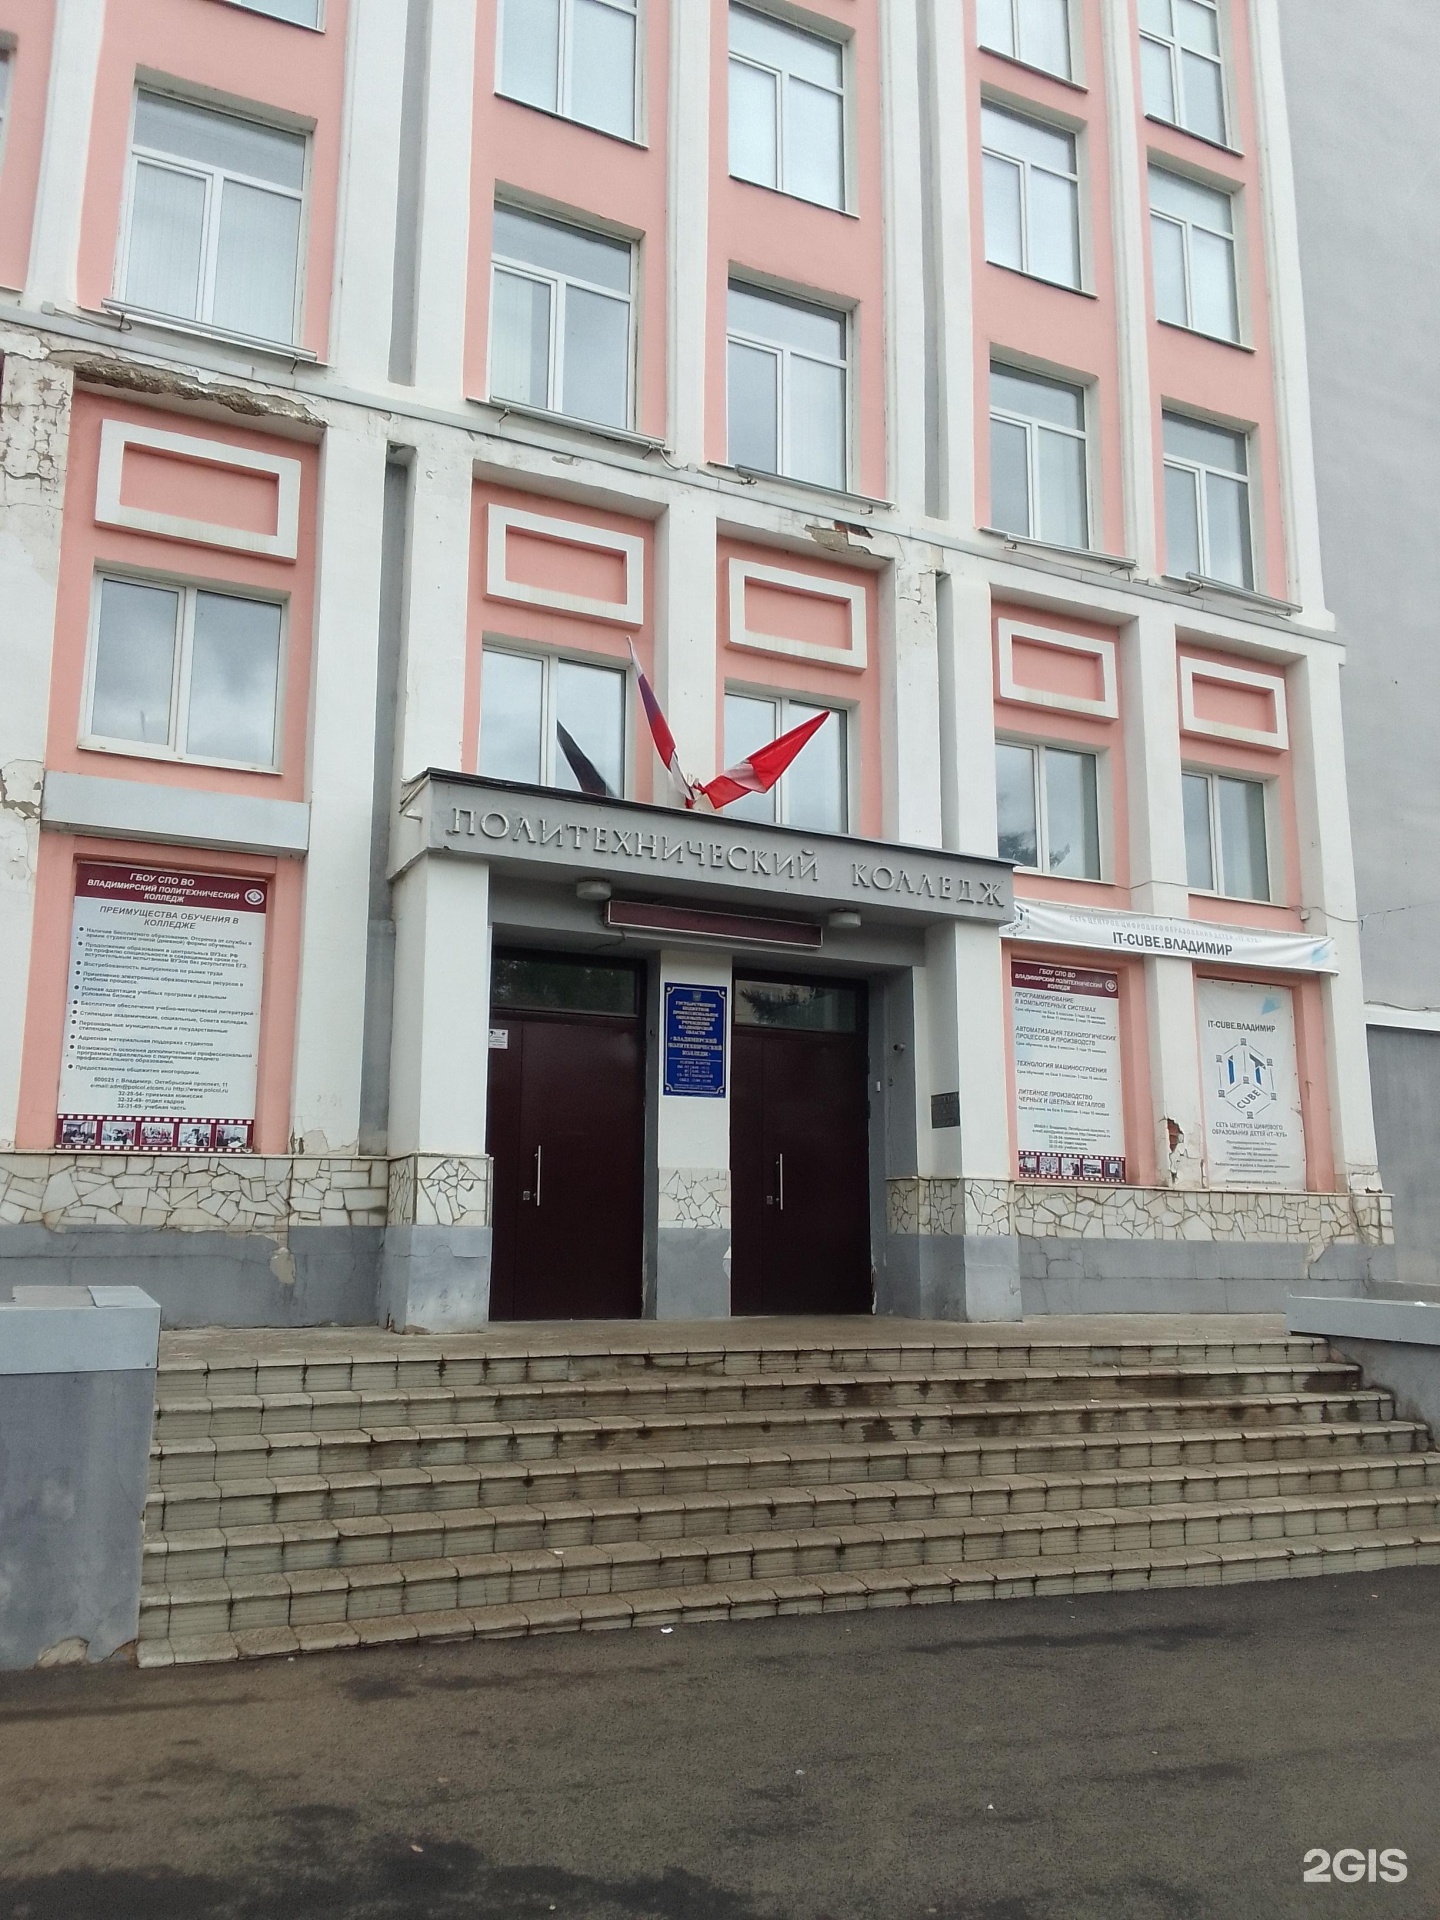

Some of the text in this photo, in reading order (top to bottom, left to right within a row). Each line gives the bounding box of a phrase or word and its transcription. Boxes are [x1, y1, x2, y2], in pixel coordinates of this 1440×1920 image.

[452, 808, 1005, 907] ПОЛИТЕХНИЧЕСКИЙ КОЛЛЕДЖ
[130, 873, 194, 886] ГБОУ СПО ВО
[87, 878, 240, 900] ВЛАДИМИРСКИЙ ПОЛИТЕХНИЧЕСКИЙ
[144, 892, 184, 904] КОЛЛЕДЖ
[100, 906, 178, 920] ПРЕИМУЩЕСТВА
[180, 912, 229, 924] ОБУЧЕНИЯ
[144, 918, 196, 930] КОЛЛЕДЖЕ
[1088, 918, 1120, 927] ЦЕНТРОВ
[1113, 932, 1232, 956] IT-CUBE.ВЛАДИМИР
[1056, 978, 1103, 988] ПОЛИТЕХНИЧЕСКИЙ
[1015, 991, 1074, 1003] ПРОГРАММИРОВАНИЕ
[1020, 1000, 1067, 1010] КОМПЬЮТЕРНЫХ
[1068, 1004, 1096, 1012] СИСТЕМАХ
[1208, 1020, 1275, 1032] IT-CUBE.ВЛАДИМИР
[1015, 1026, 1116, 1041] АВТОМАТИЗАЦИЯ ТЕХНОЛОГИЧЕСКИХ
[1016, 1033, 1050, 1042] ПРОЦЕССОВ
[1056, 1037, 1095, 1046] ПРОИЗВОДСТВ
[1017, 1060, 1107, 1073] ТЕХНОЛОГИЯ МАШИНОСТРОЕНИЯ
[1049, 1092, 1092, 1100] ПРОИЗВОДСТВО
[1236, 1090, 1262, 1109] CUBE
